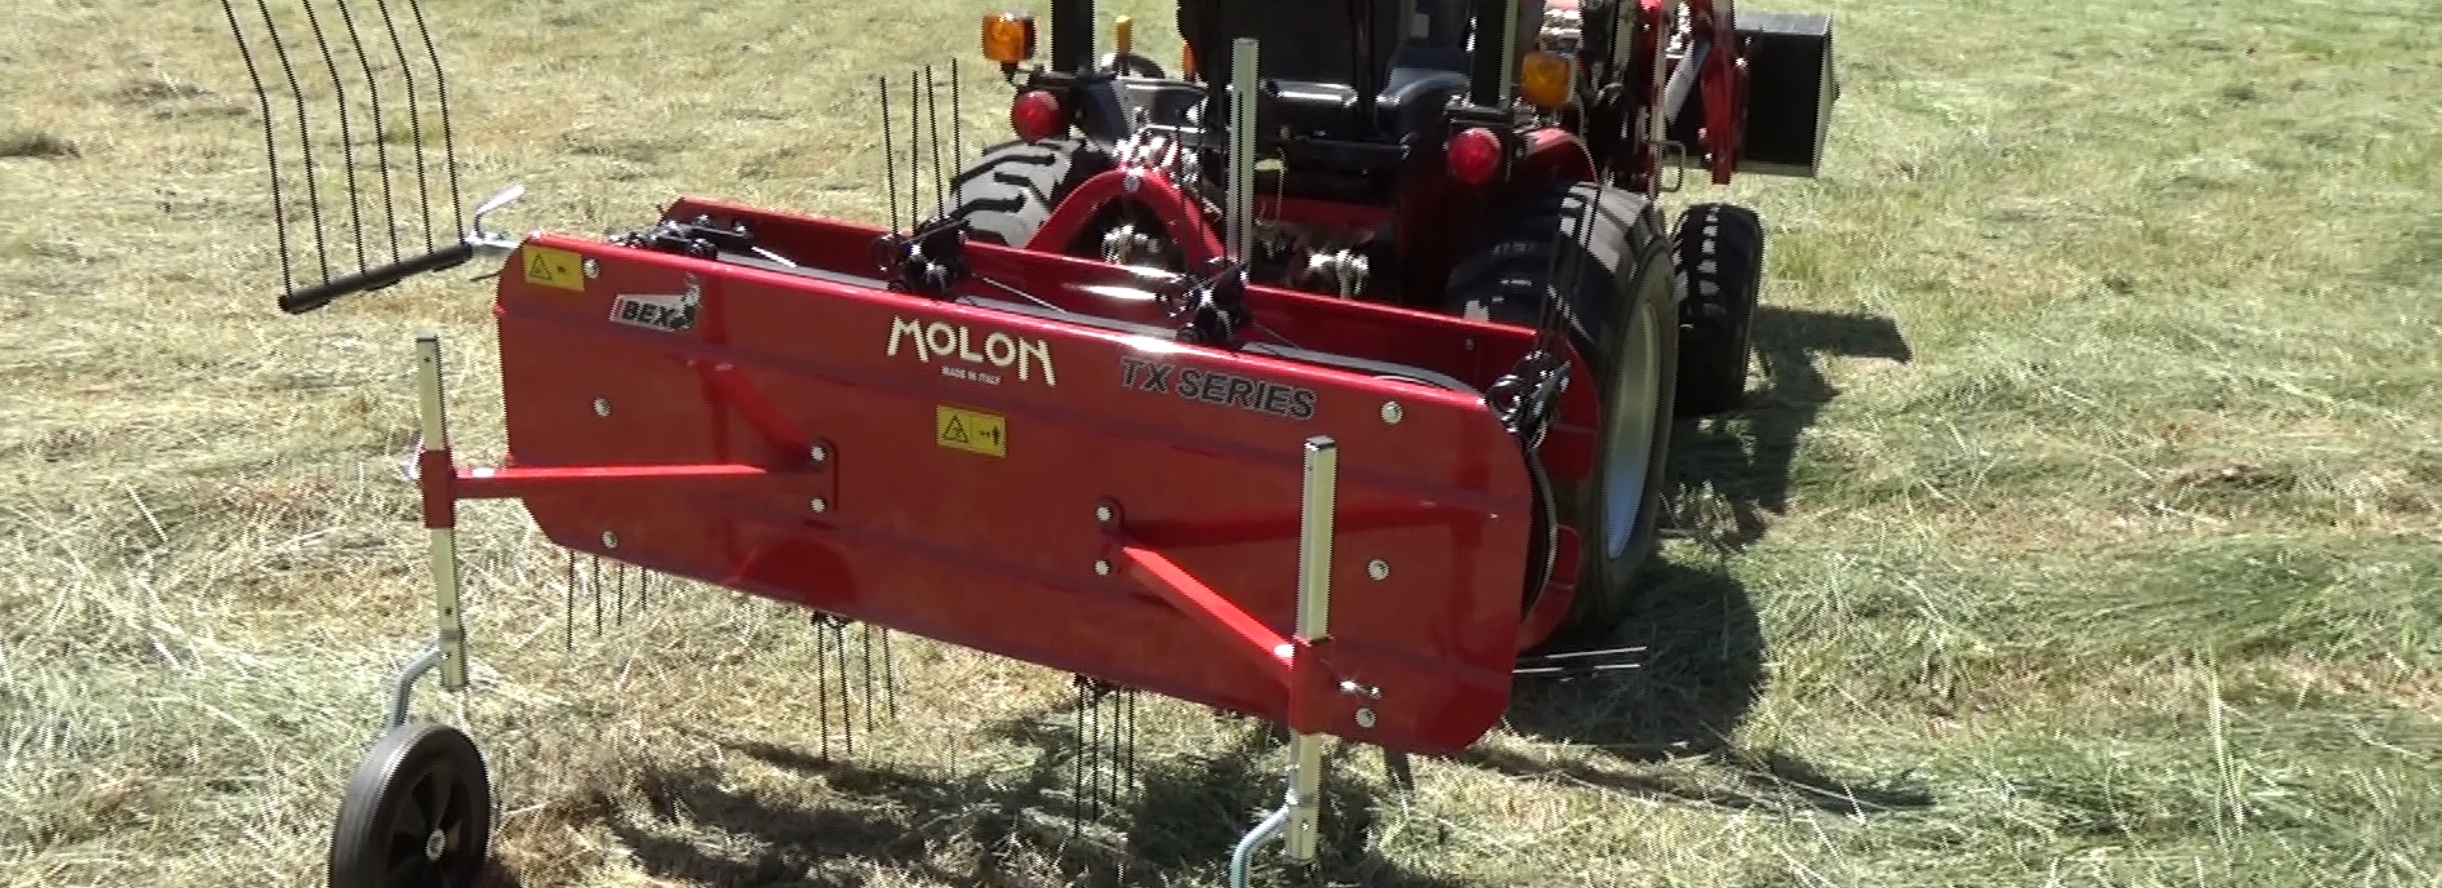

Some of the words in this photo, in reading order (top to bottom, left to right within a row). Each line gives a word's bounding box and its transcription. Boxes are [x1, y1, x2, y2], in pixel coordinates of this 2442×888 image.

[887, 315, 1055, 386] MOLON
[1120, 356, 1176, 394] TX
[1176, 367, 1317, 421] SERIES
